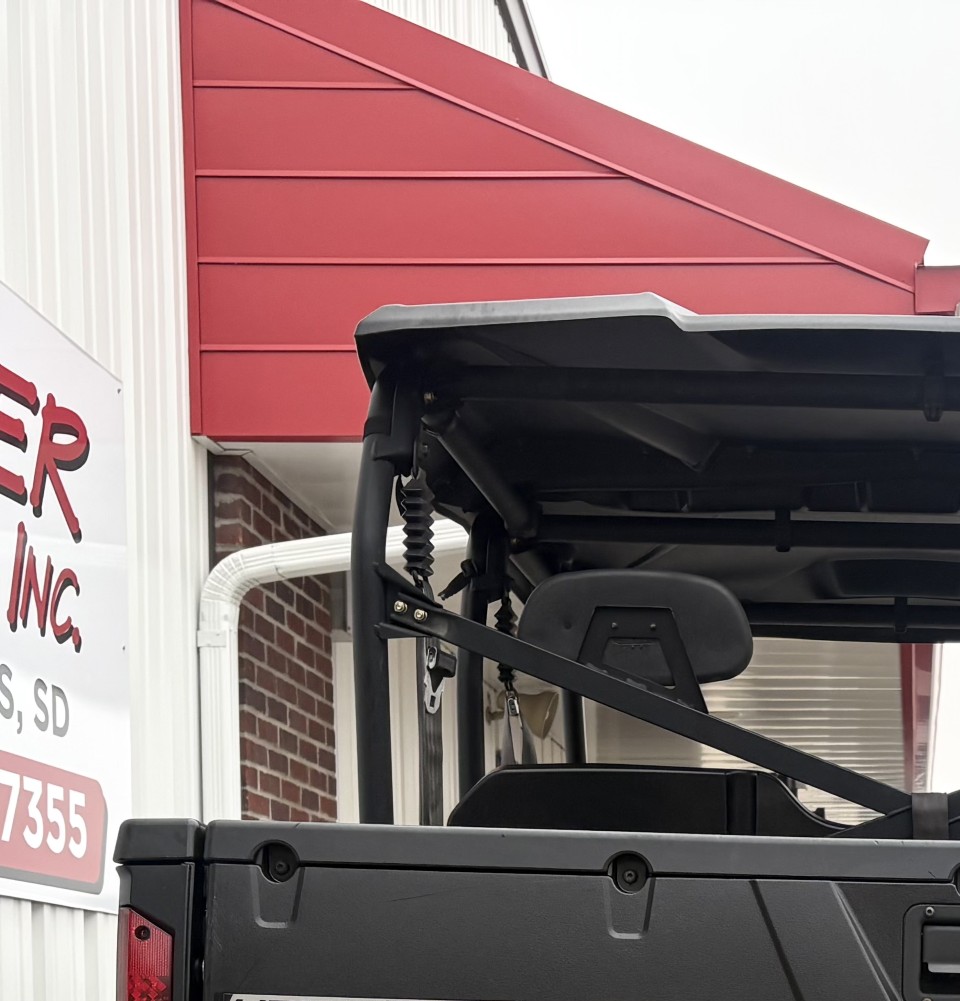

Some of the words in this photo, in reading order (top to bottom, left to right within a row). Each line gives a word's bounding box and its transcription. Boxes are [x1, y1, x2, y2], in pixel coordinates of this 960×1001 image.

[7, 521, 82, 653] INC.
[33, 678, 69, 737] SD
[0, 768, 87, 859] 7355
